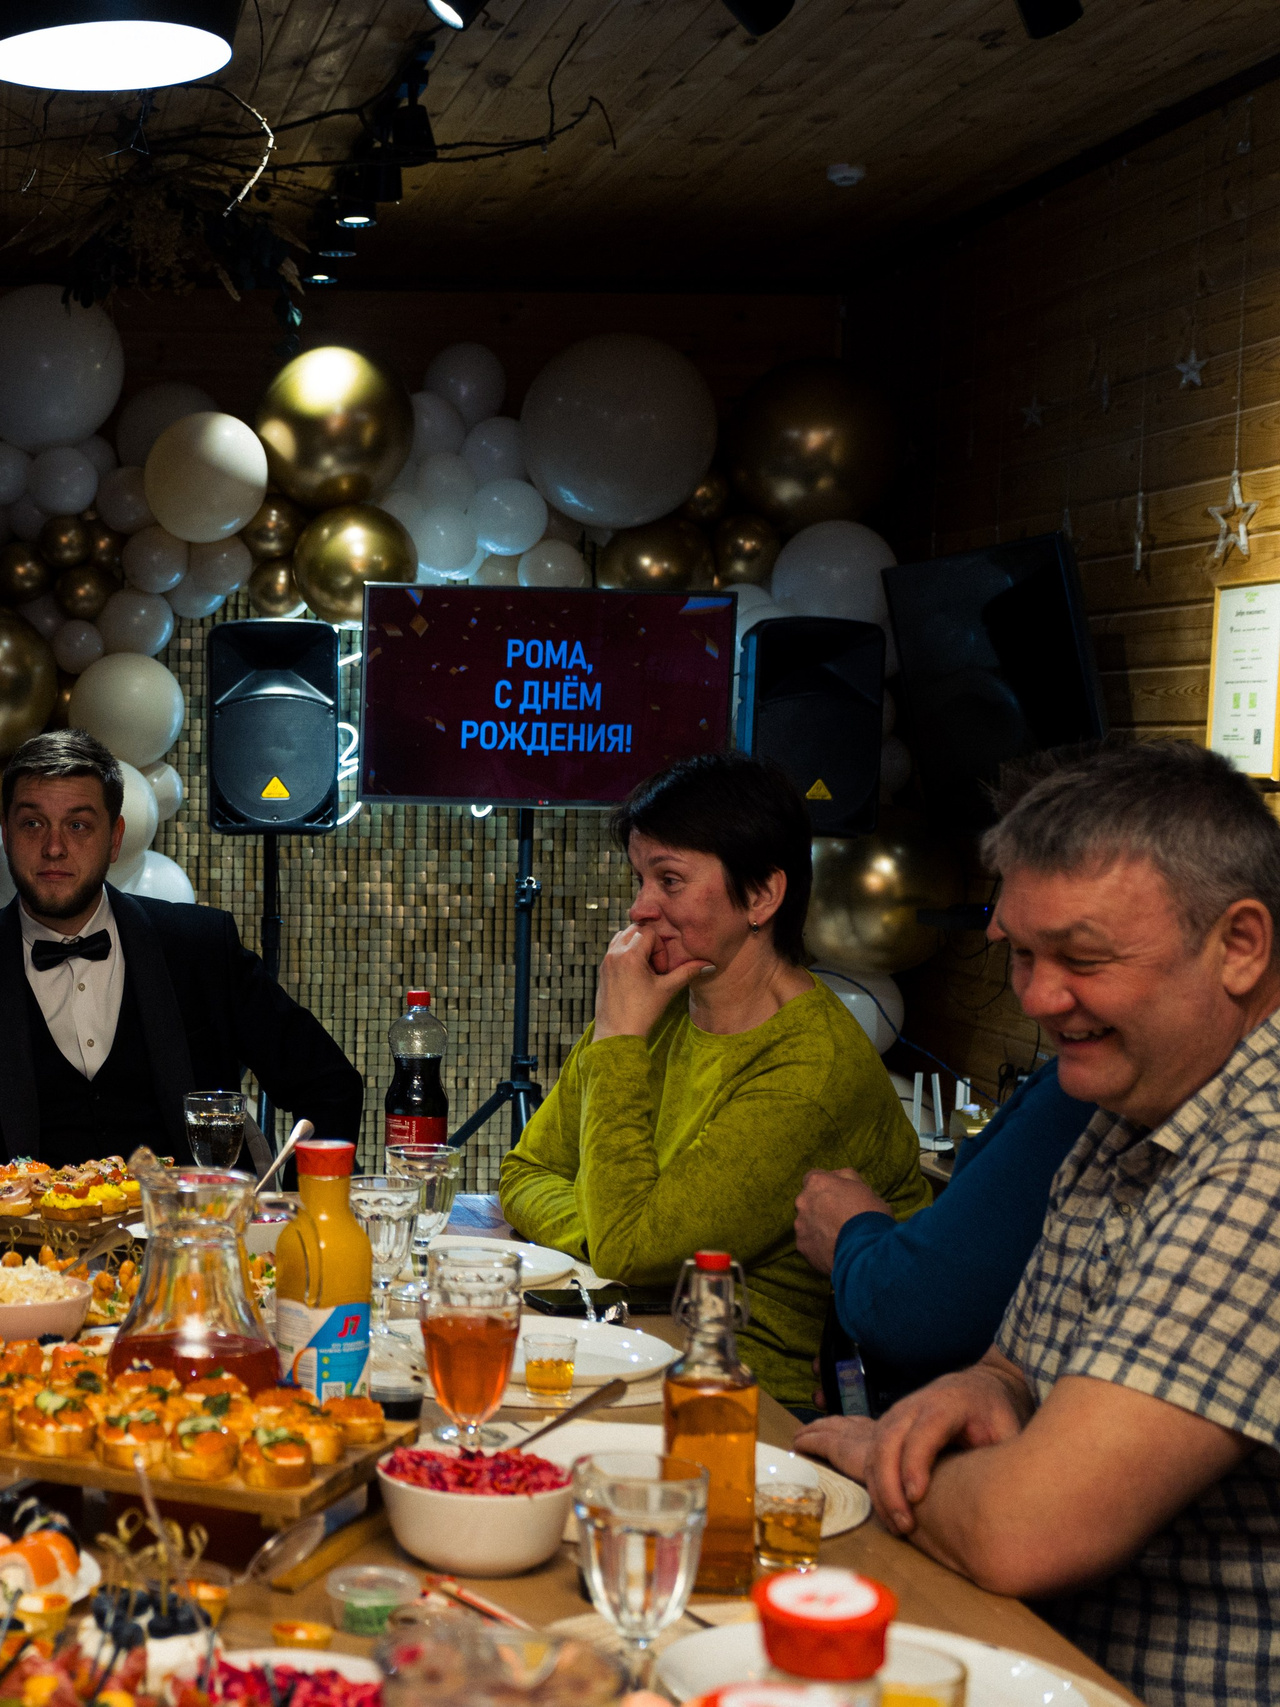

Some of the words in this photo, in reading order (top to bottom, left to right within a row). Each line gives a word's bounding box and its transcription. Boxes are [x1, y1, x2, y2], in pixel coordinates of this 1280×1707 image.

[506, 638, 594, 676] РОМА,
[494, 679, 513, 710] С
[518, 674, 603, 716] ДНЁМ
[460, 719, 634, 757] РОЖДЕНИЯ!
[337, 1315, 362, 1338] J7
